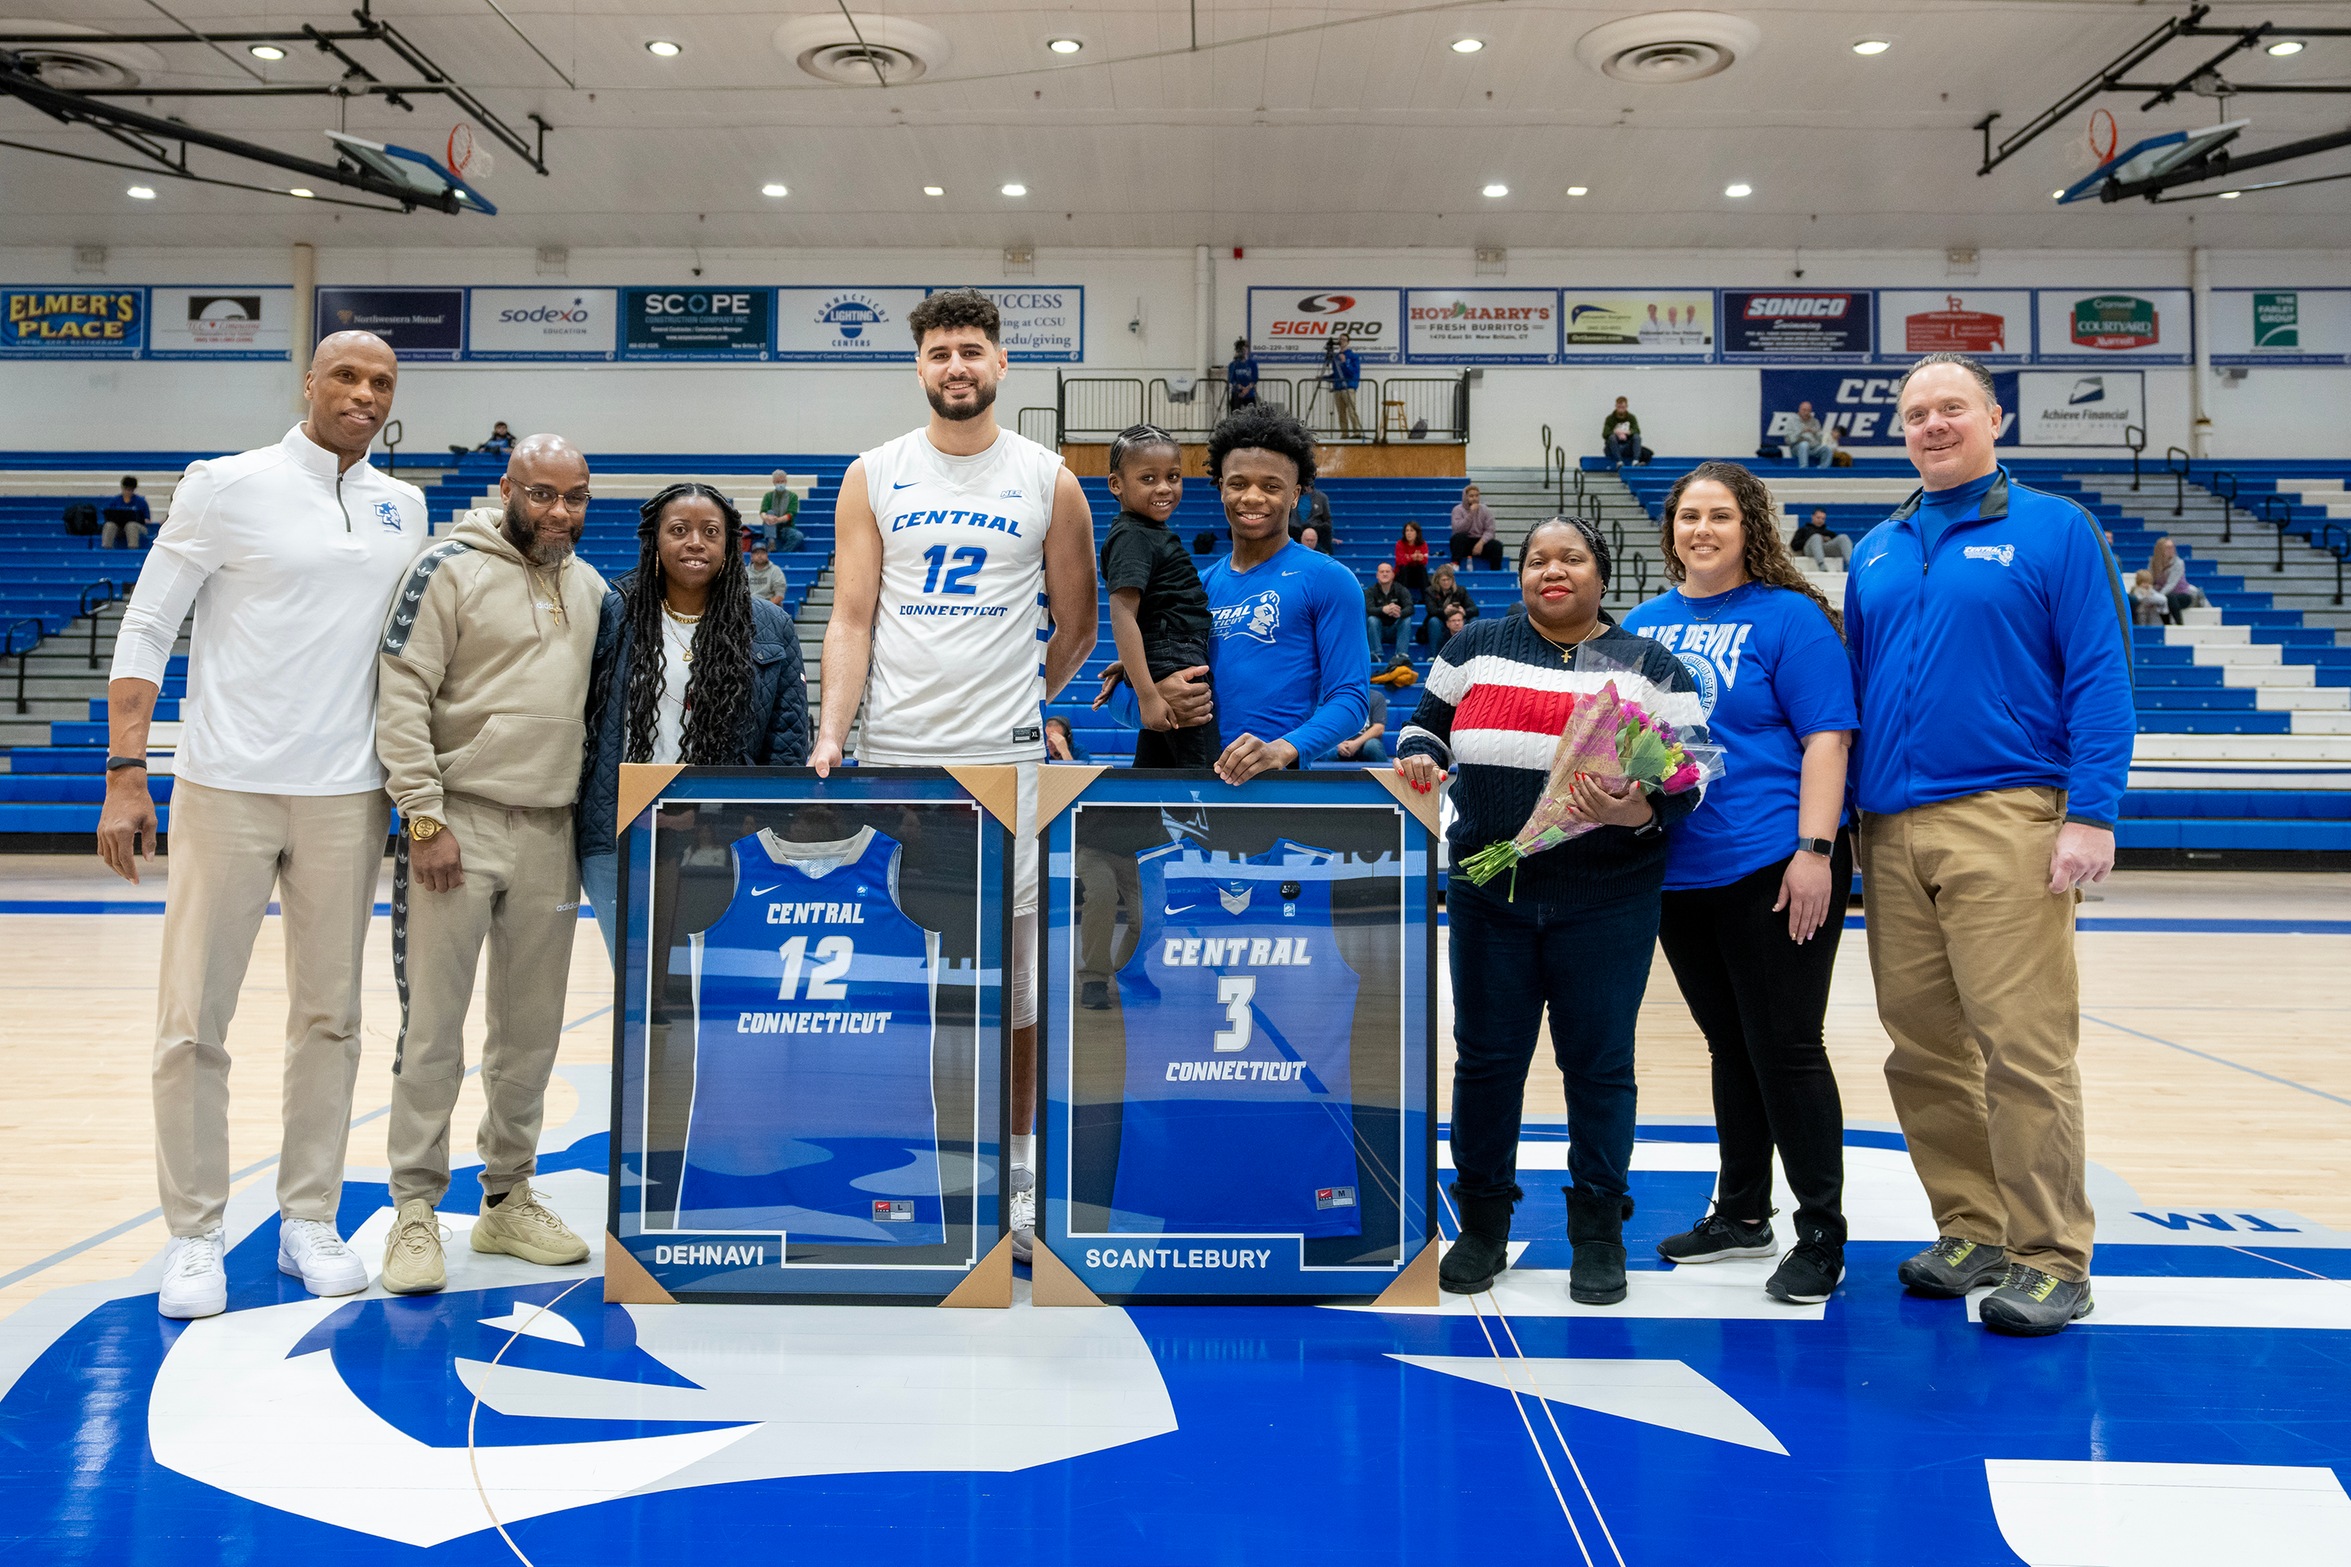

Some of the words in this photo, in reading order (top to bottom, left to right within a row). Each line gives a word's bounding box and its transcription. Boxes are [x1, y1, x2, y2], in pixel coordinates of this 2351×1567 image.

[9, 294, 133, 322] ELMER'S
[645, 294, 751, 314] SCOPE
[814, 294, 889, 323] CONNECTICUT
[988, 294, 1062, 308] UCCESS
[353, 314, 410, 323] Northwestern
[412, 314, 444, 323] Mutual
[499, 305, 588, 323] sodexo
[645, 316, 698, 324] CONSTRUCTION
[700, 316, 734, 324] COMPANY
[830, 310, 874, 321] LIGHTING
[1034, 317, 1066, 326] CCSU
[1411, 307, 1451, 320] HOT
[1463, 307, 1549, 320] HARRY'S
[2260, 314, 2295, 323] GROUP
[18, 321, 124, 338] PLACE
[1270, 321, 1328, 335] SIGN
[1331, 321, 1382, 335] PRO
[2078, 321, 2152, 333] COURTYARD
[1766, 411, 1880, 437] BUE
[2042, 409, 2080, 419] Achieve
[2082, 409, 2129, 420] Financial
[892, 510, 1022, 538] CENTRAL
[922, 543, 988, 596] 12
[900, 605, 1008, 616] CONNECTICUT
[1211, 605, 1251, 620] TRAL
[1702, 677, 1714, 713] STATE
[766, 903, 864, 924] CENTRAL
[1162, 938, 1312, 967] CENTRAL
[778, 935, 854, 1000] 12
[737, 1012, 892, 1033] CONNECTICUT
[1213, 975, 1256, 1052] 3
[1165, 1061, 1306, 1082] CONNECTICUT
[655, 1245, 763, 1265] DEHNAVI
[1085, 1248, 1271, 1269] SCANTLEBURY
